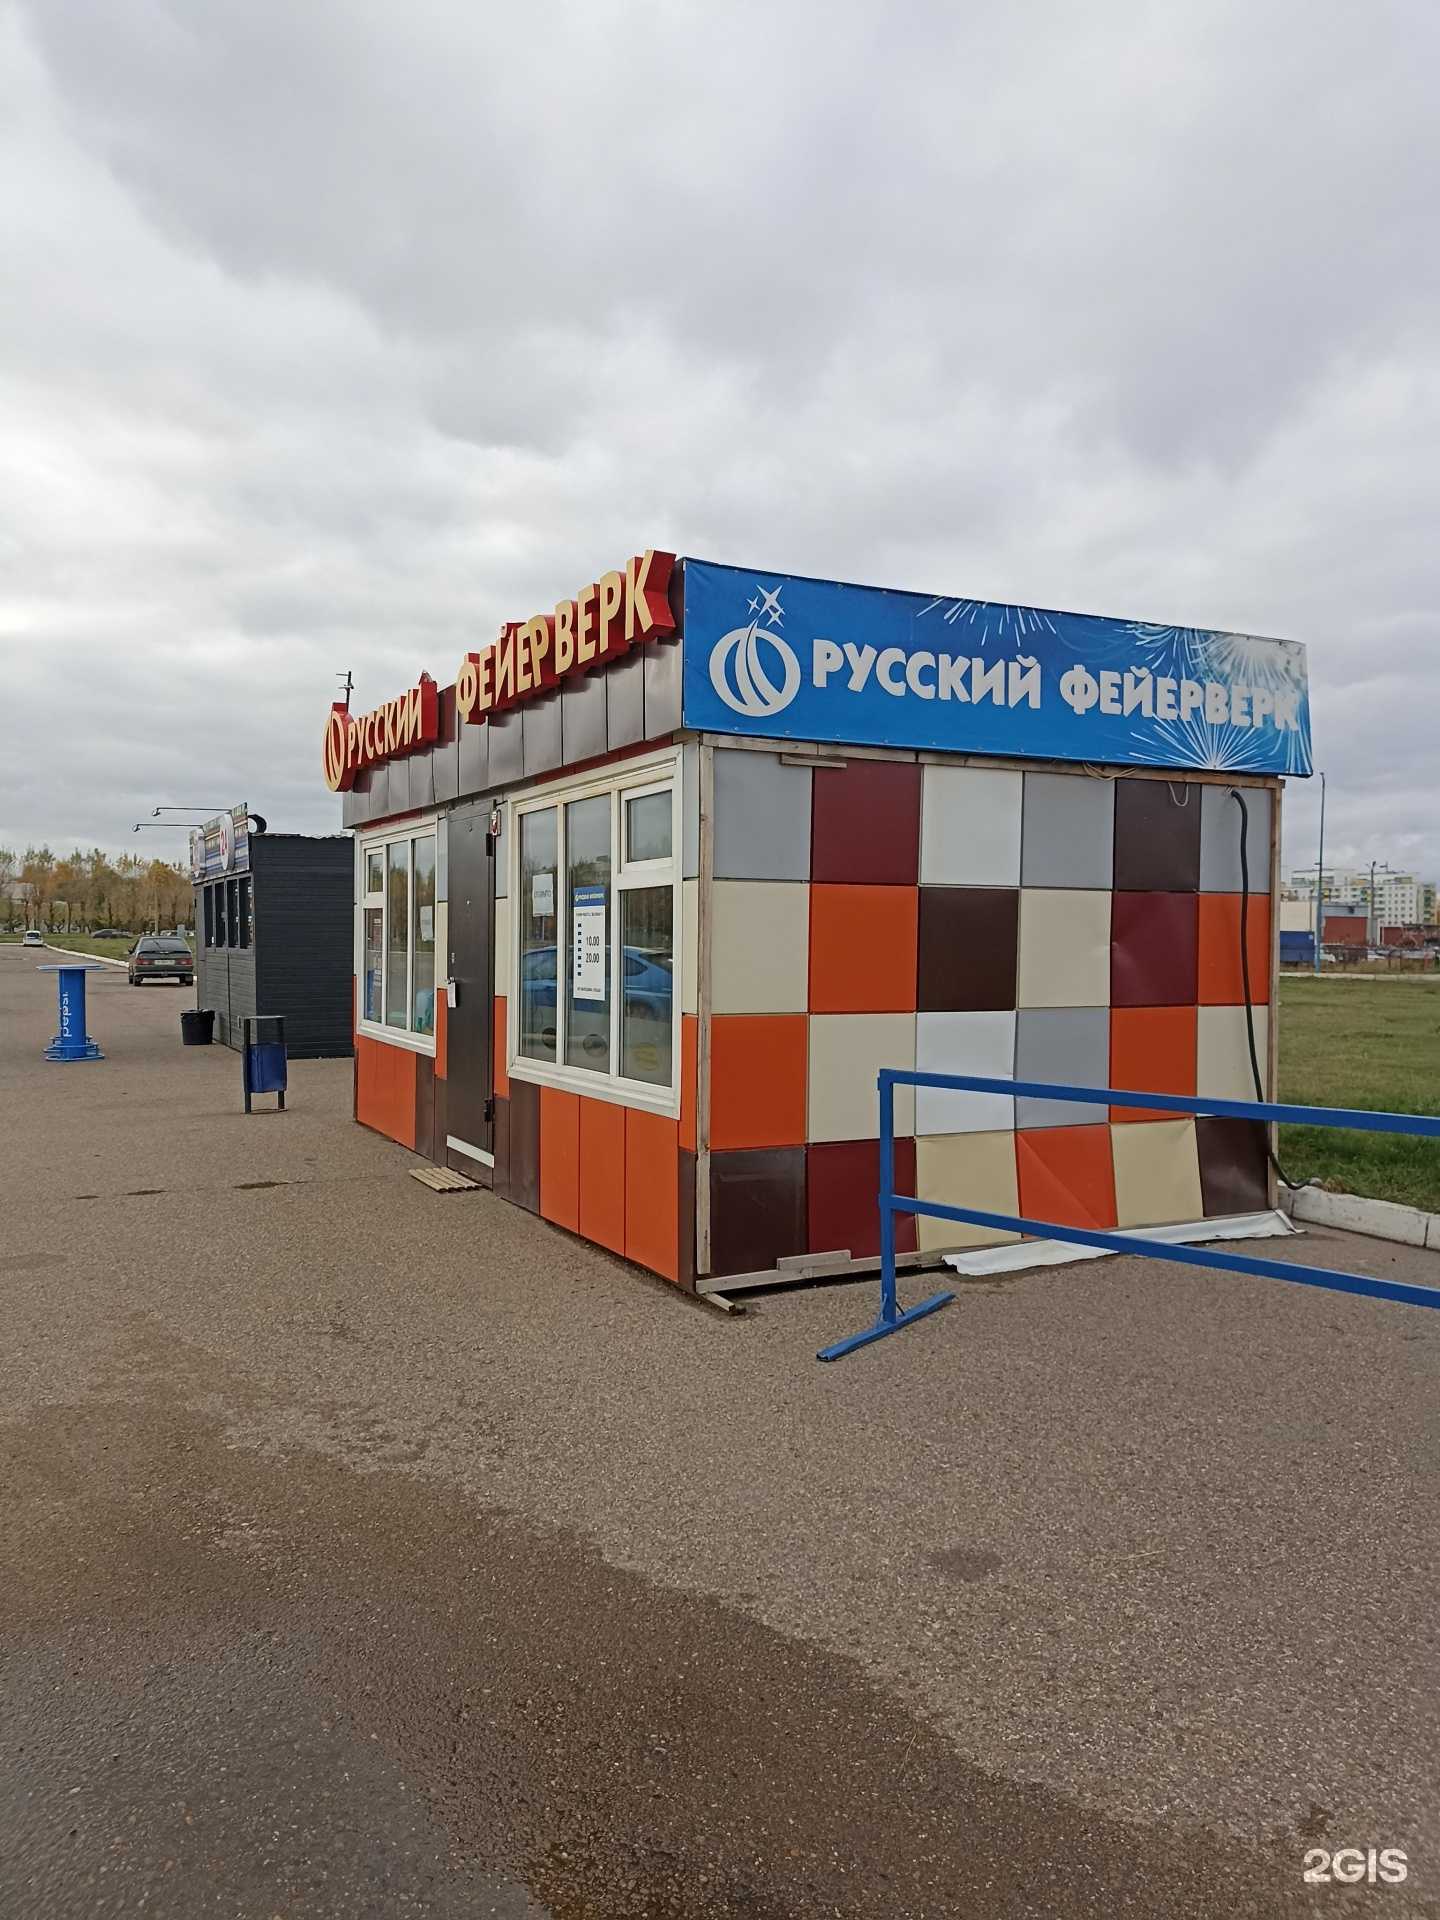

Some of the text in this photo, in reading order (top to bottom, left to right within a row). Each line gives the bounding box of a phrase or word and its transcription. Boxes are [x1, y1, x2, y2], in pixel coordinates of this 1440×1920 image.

[813, 639, 1300, 731] РУССКИЙ ФЕЙЕРВЕРК
[586, 935, 600, 947] 10.00
[585, 952, 600, 964] 20.00
[62, 991, 72, 1037] pepsi
